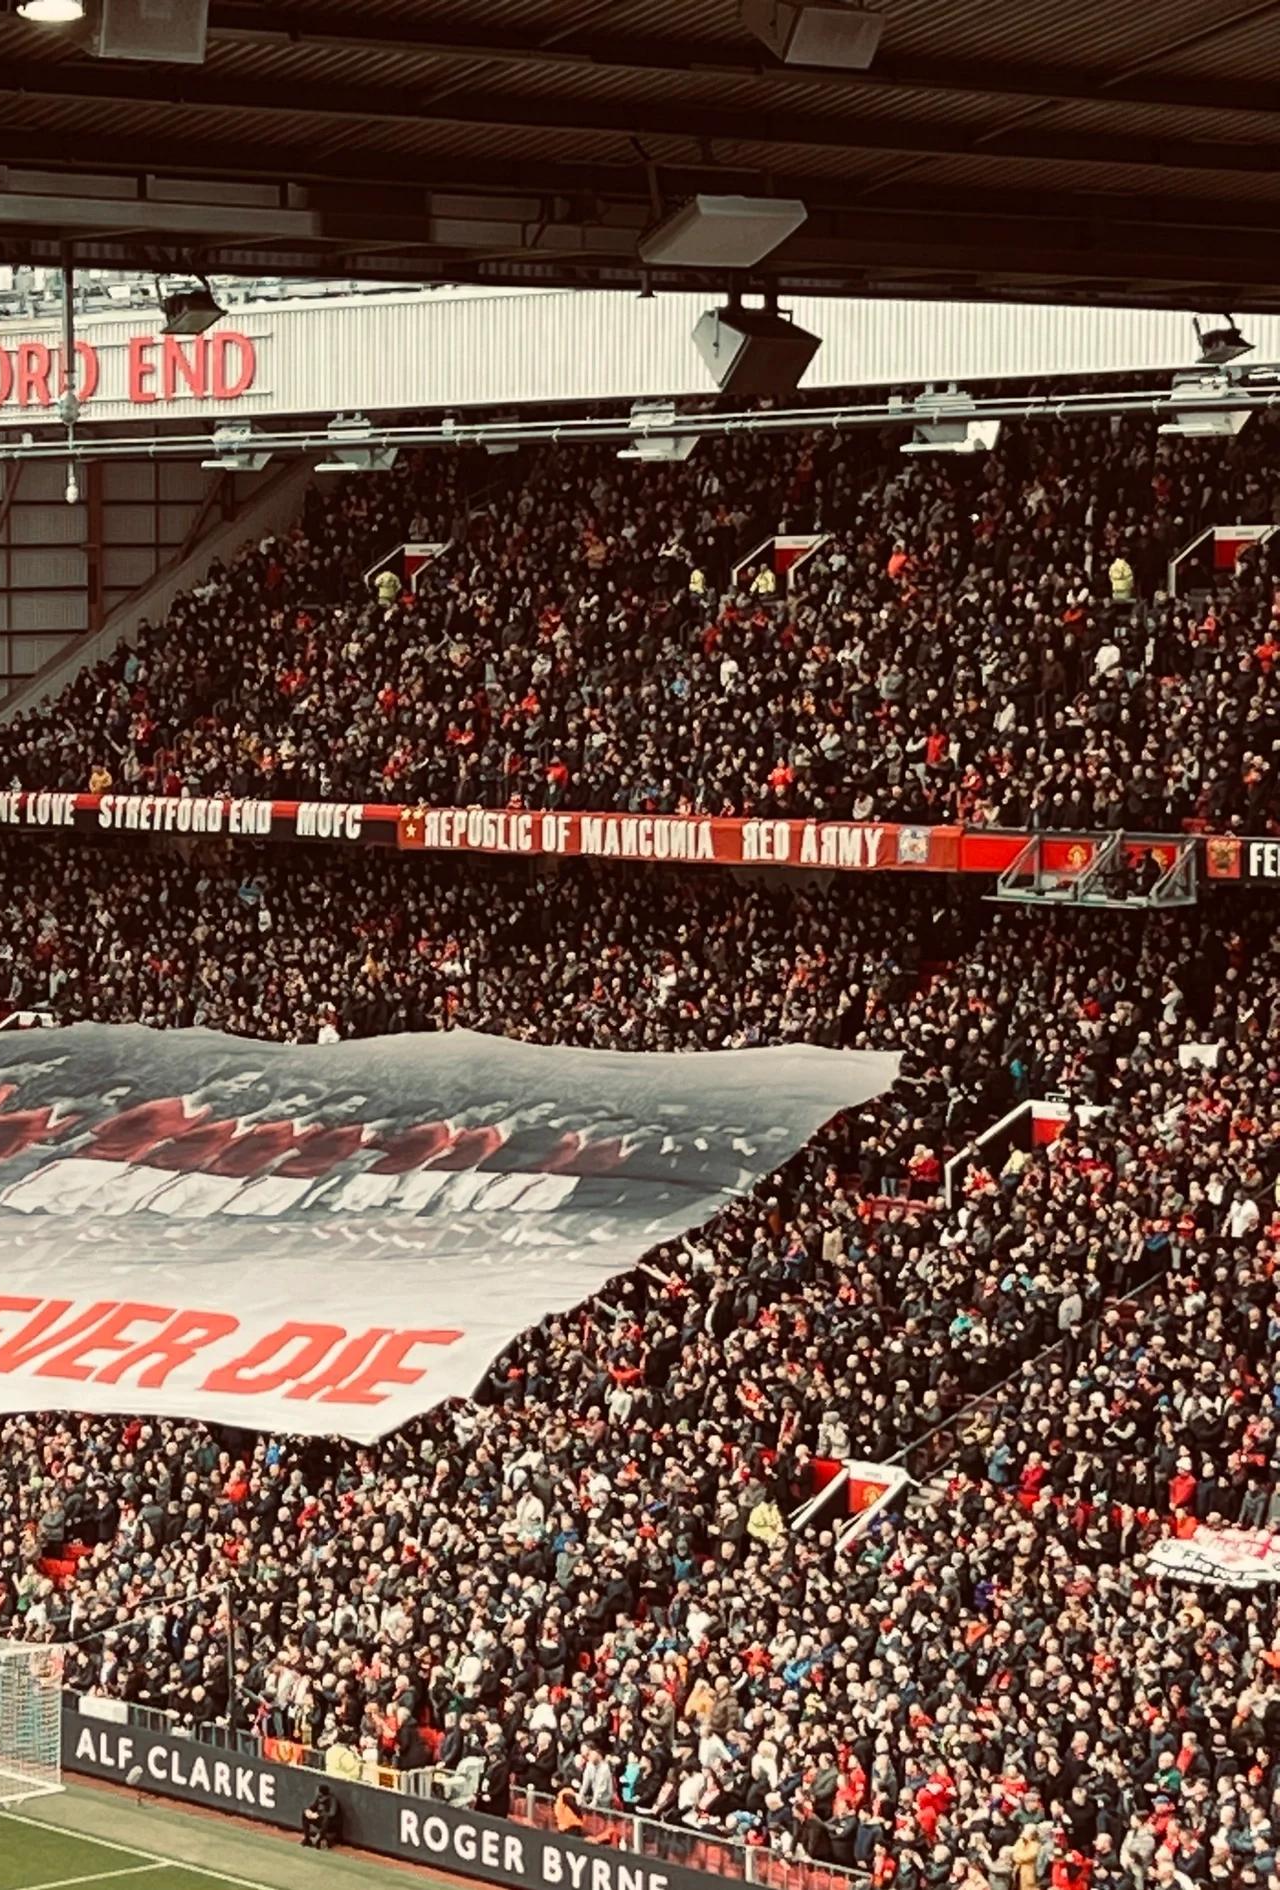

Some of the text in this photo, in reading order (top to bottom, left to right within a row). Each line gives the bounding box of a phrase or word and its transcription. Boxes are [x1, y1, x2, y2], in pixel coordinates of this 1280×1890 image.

[128, 330, 256, 405] END
[26, 792, 76, 826] LOVE
[98, 794, 222, 833] STRETFORD
[228, 799, 272, 834] END
[296, 801, 363, 840] MUFC
[541, 815, 573, 853] OF
[194, 1320, 465, 1405] DIE
[75, 1728, 276, 1809] ALF CLARKE
[399, 1808, 526, 1875] ROGER
